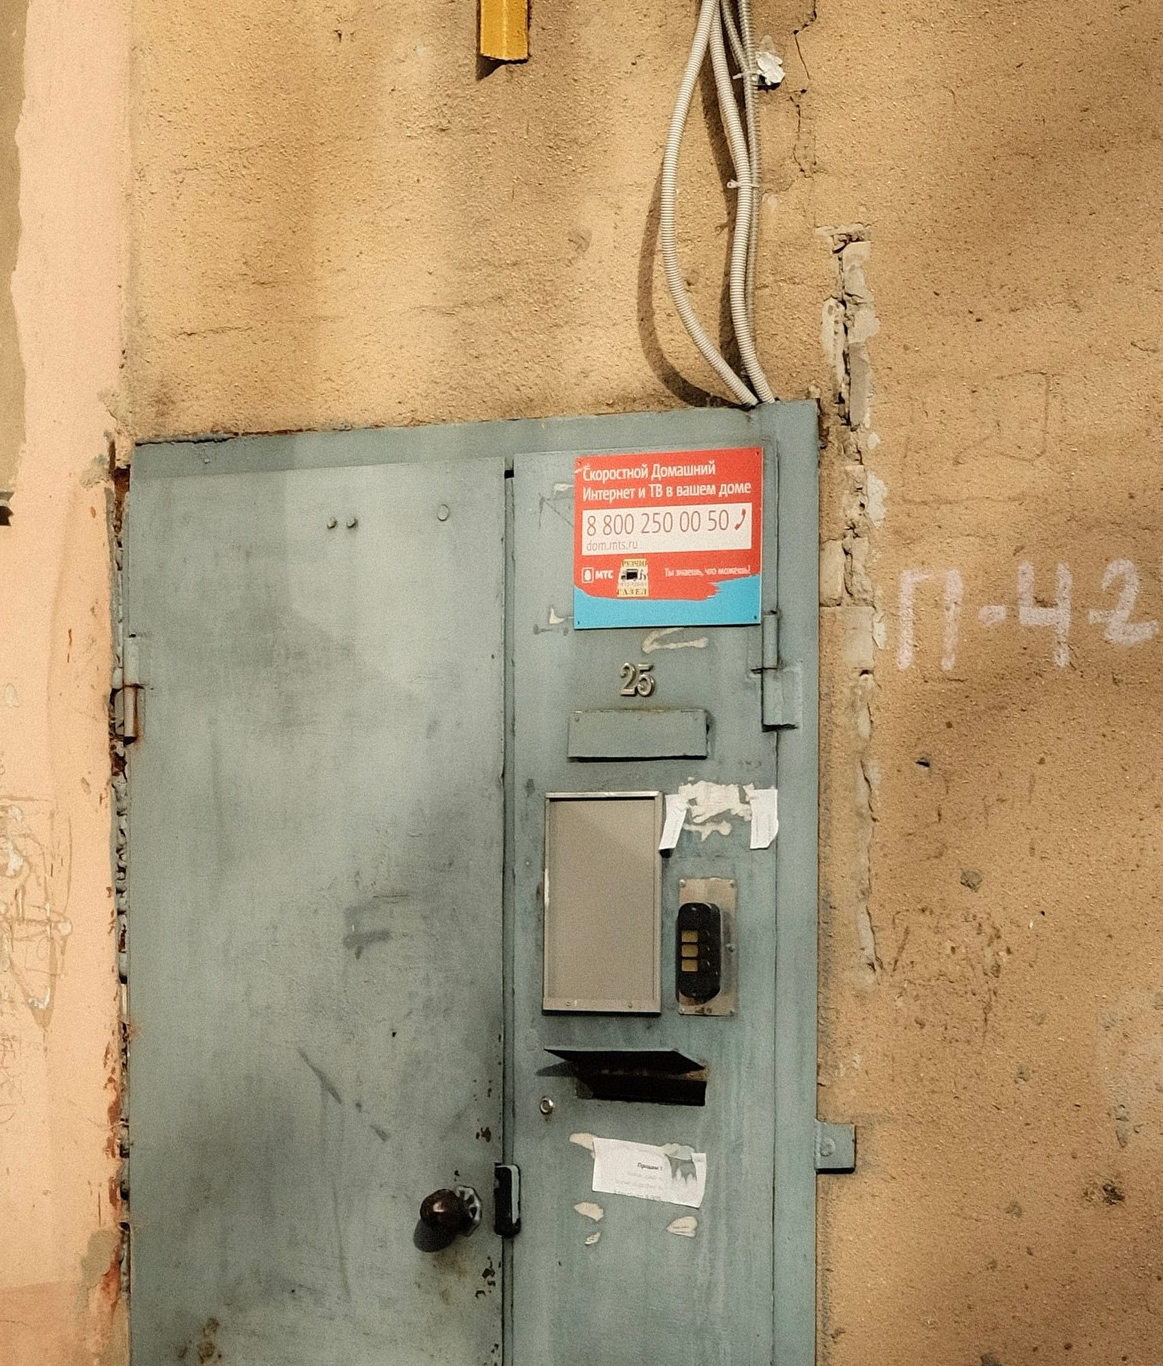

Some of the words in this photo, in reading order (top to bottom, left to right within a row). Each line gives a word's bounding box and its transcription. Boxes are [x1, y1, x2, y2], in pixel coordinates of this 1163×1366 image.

[582, 463, 649, 484] Скоростной
[651, 460, 716, 480] Домашний
[582, 487, 635, 504] Интернет
[638, 489, 646, 499] и
[648, 483, 663, 498] ТВ
[666, 487, 673, 497] в
[676, 484, 716, 497] вашем
[718, 482, 751, 498] доме
[586, 514, 597, 537] 8
[602, 512, 635, 535] 800
[640, 510, 673, 534] 250
[679, 509, 702, 533] 00
[708, 508, 729, 531] 50
[586, 539, 638, 552] dom.mts.ru
[594, 569, 614, 580] МТС
[664, 567, 675, 577] Ты
[619, 661, 655, 697] 25
